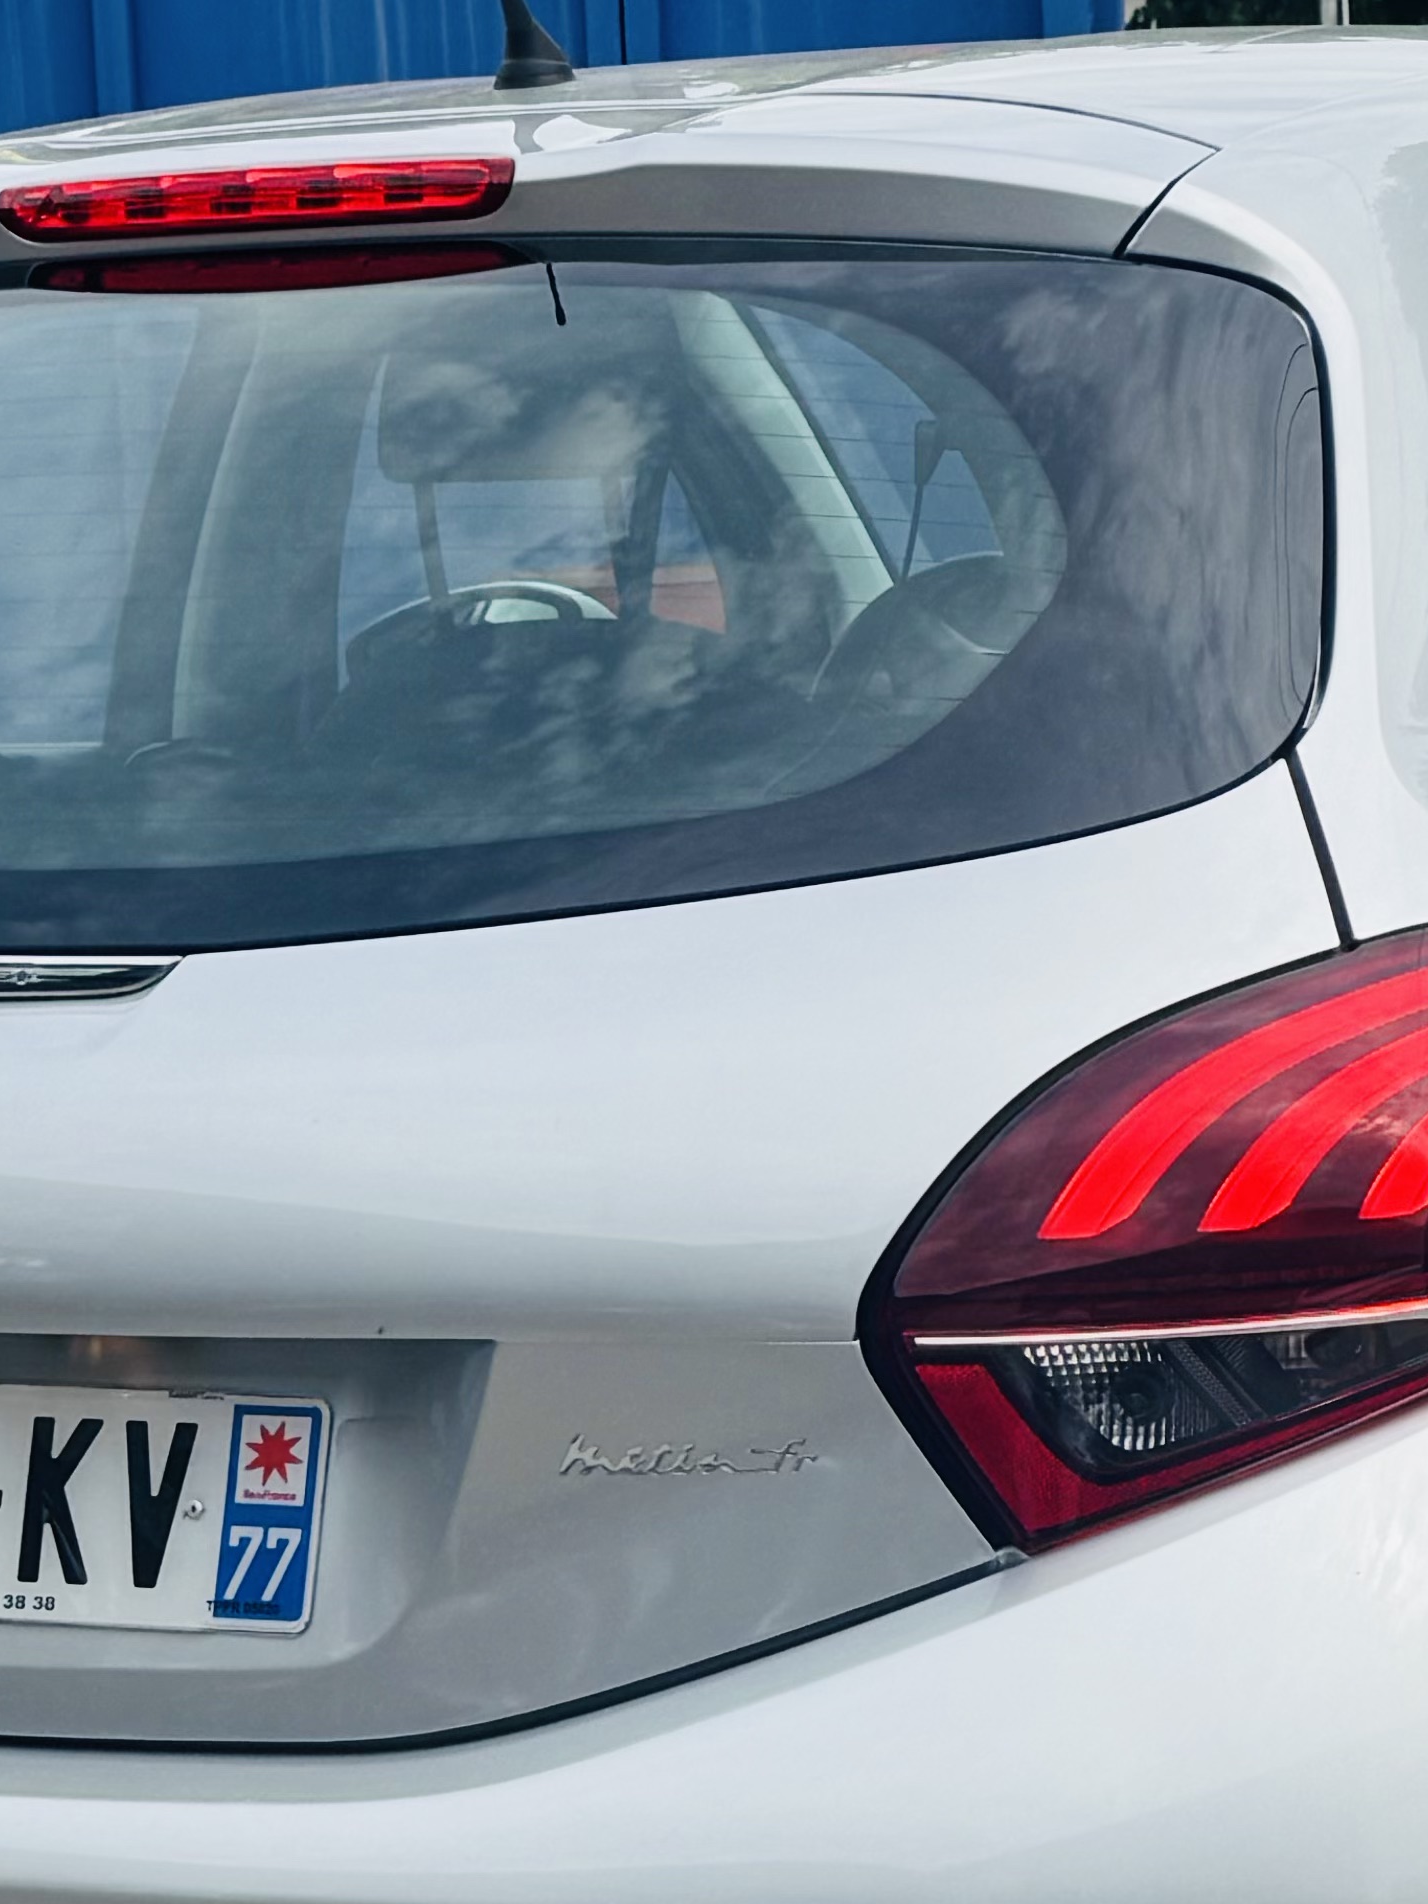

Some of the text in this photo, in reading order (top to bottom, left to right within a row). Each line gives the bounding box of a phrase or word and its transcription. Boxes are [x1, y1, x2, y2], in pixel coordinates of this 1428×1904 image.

[222, 1525, 303, 1602] 77
[3, 1594, 27, 1610] 38
[32, 1595, 56, 1611] 38
